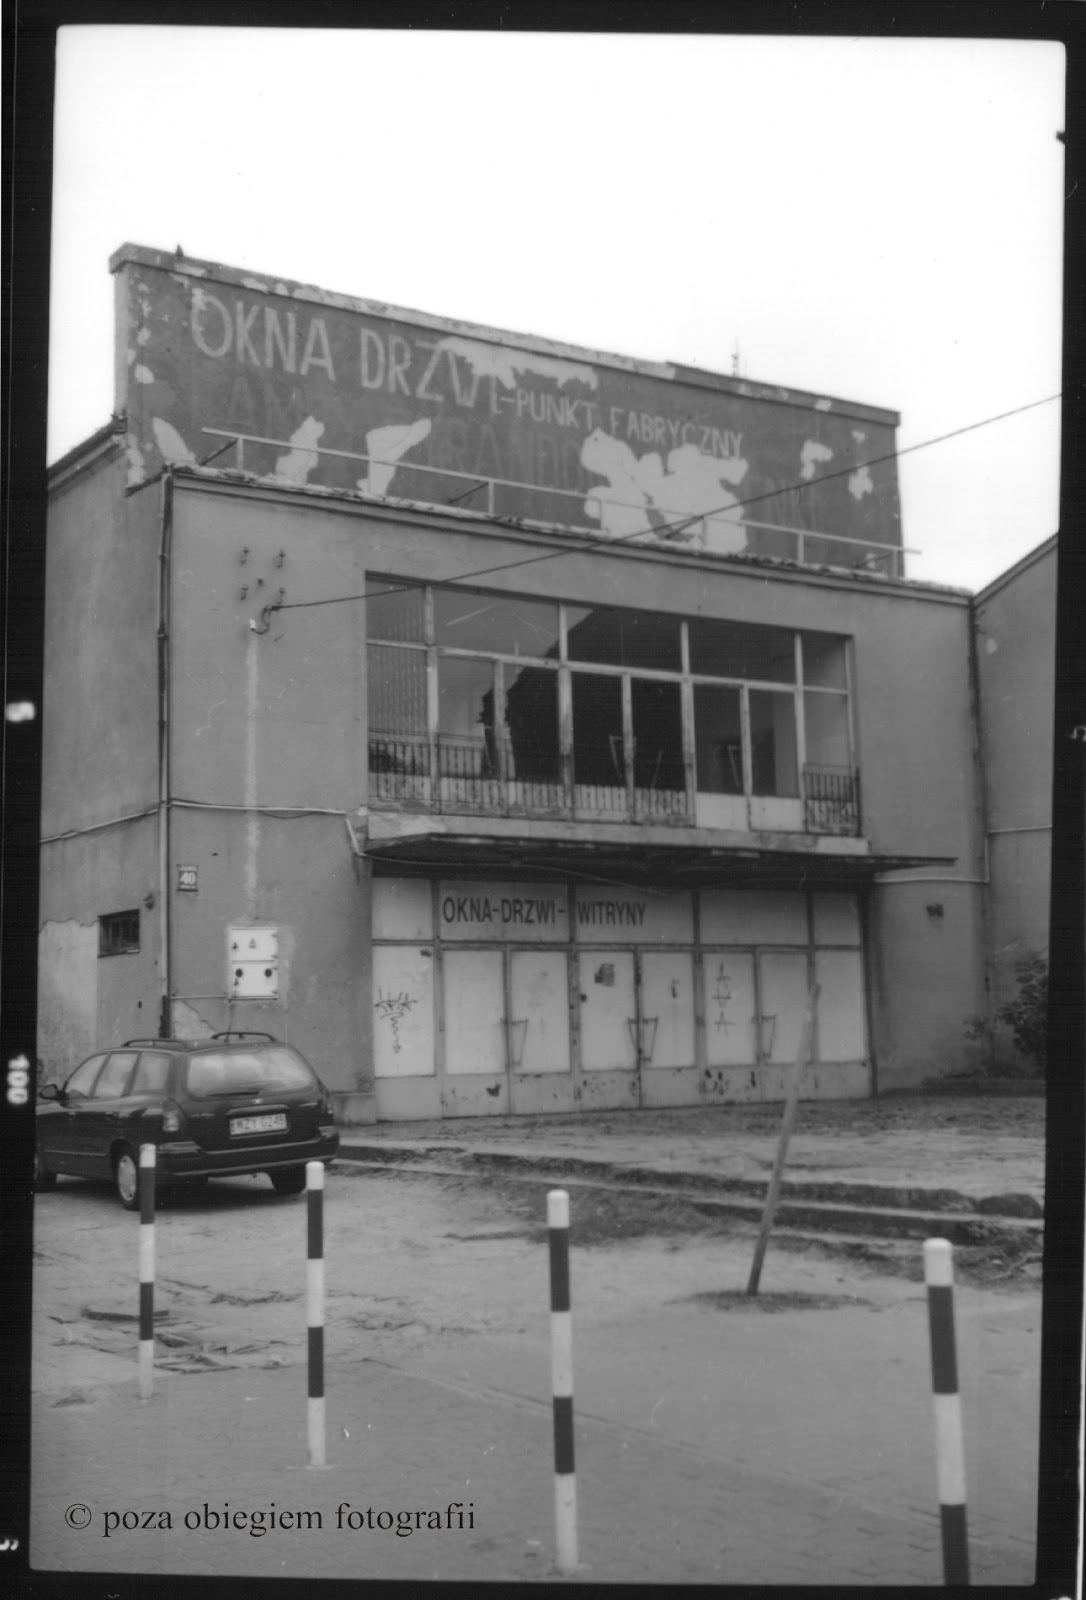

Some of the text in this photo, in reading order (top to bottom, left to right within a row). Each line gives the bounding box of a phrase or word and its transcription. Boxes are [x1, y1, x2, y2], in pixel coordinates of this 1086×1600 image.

[190, 292, 336, 382] OKNA
[610, 406, 743, 458] FABRYCZNY
[179, 871, 196, 885] 40
[577, 901, 647, 928] WITRYNY
